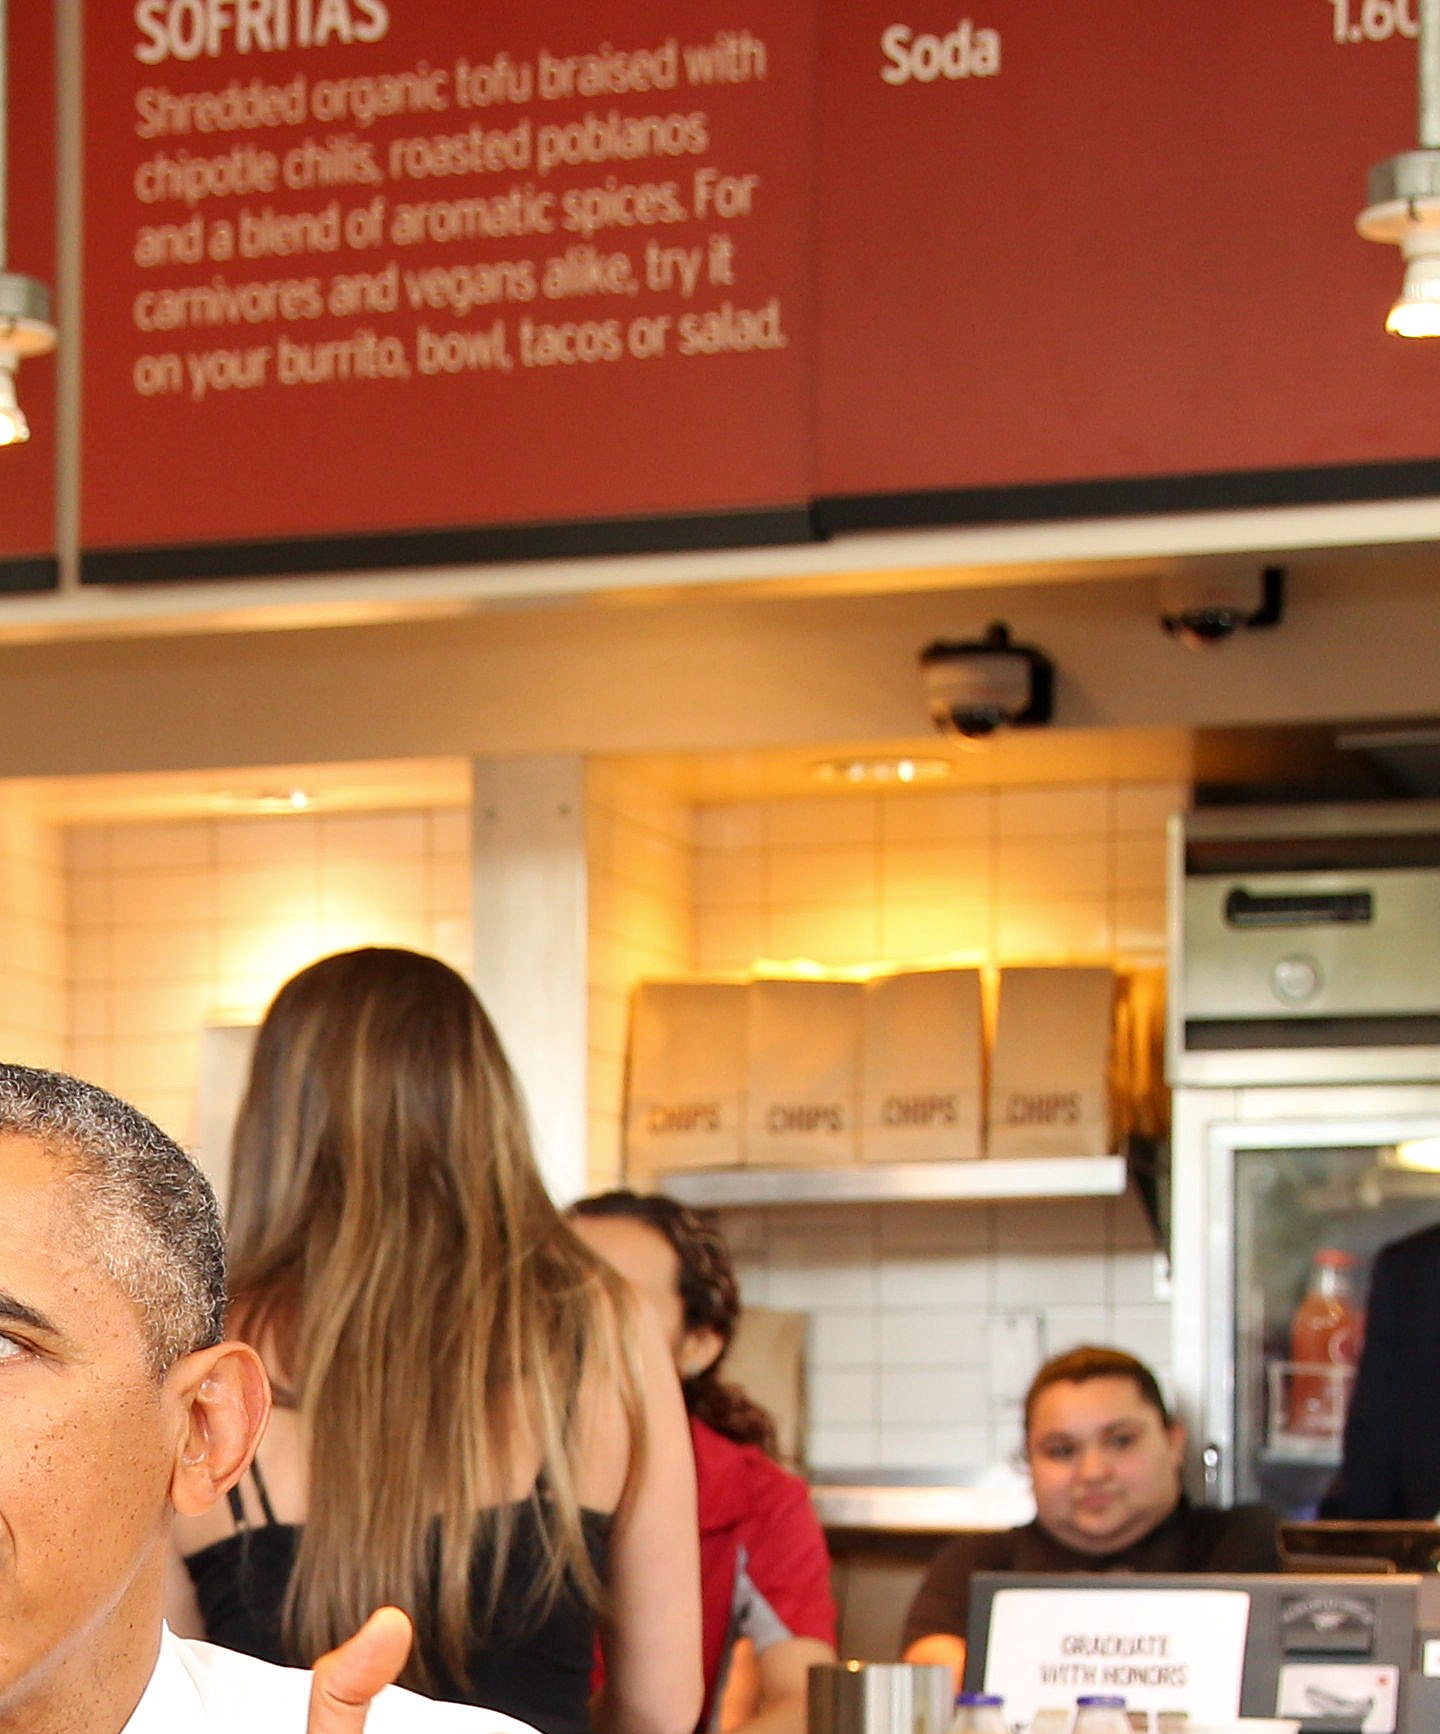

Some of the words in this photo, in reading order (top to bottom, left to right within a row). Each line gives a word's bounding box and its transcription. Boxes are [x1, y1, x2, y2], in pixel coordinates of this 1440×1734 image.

[134, 0, 388, 64] SOFRITAS
[881, 19, 1002, 85] Soda
[134, 74, 306, 139] Shredded
[312, 58, 448, 128] organic
[455, 52, 531, 110] tofu
[538, 38, 678, 101] braised
[683, 29, 767, 85] with
[134, 144, 278, 207] chipotle
[388, 119, 531, 180] roasted
[538, 110, 709, 176] poblanos
[134, 214, 204, 267] and
[209, 220, 233, 262] a
[239, 201, 340, 259] blend
[346, 196, 387, 248] of
[391, 181, 555, 247] aromatic
[693, 167, 761, 219] For
[134, 274, 322, 333] carnivores
[327, 261, 400, 314] and
[404, 258, 537, 318] vegans
[643, 237, 701, 297] try
[707, 232, 735, 286] it
[133, 351, 183, 397] on
[189, 344, 272, 402] your
[519, 316, 621, 368] tacos
[627, 314, 669, 361] or
[648, 1104, 719, 1133] CHIPS
[766, 1105, 844, 1134] CHIPS
[882, 1096, 959, 1129] CHIPS
[1006, 1093, 1080, 1127] CHIPS
[1039, 1663, 1097, 1687] WITH
[1102, 1662, 1189, 1688] HONORS
[1060, 1634, 1170, 1660] GRADUATE
